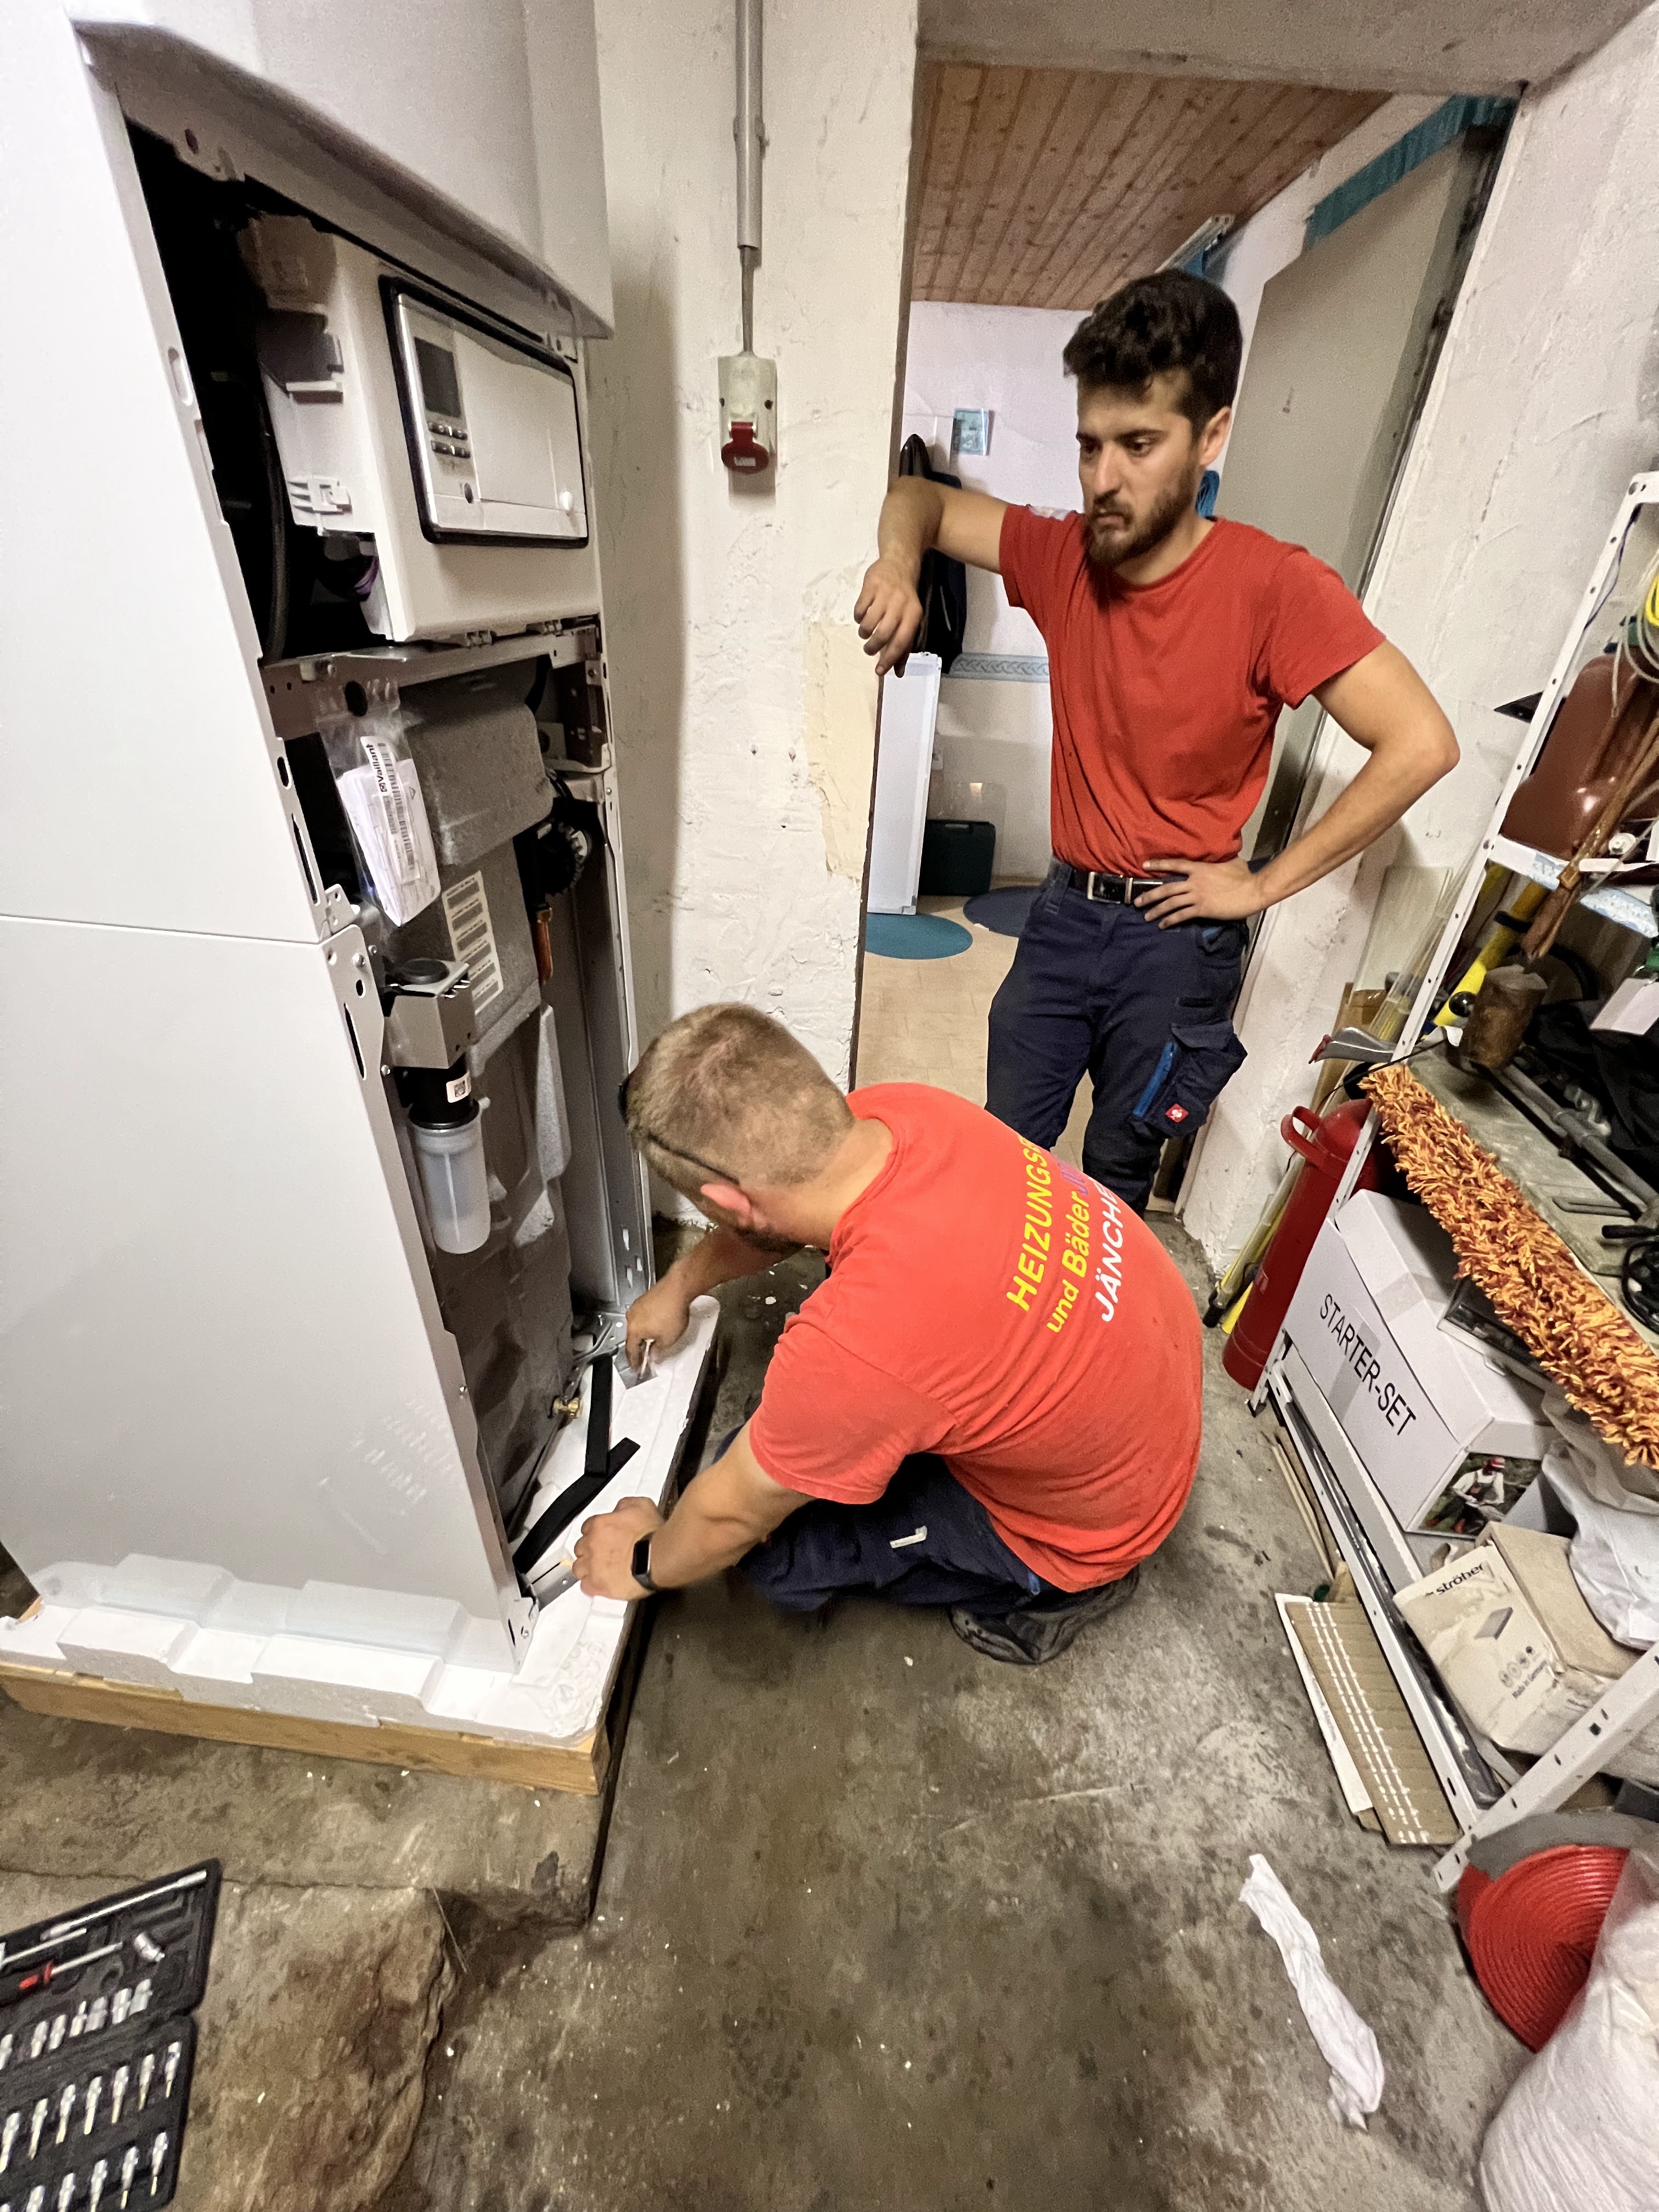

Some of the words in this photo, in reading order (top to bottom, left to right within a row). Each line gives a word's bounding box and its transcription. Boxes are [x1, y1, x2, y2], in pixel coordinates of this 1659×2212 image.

[365, 744, 384, 782] Vaillant
[1062, 1191, 1090, 1278] Bäder
[1088, 1177, 1124, 1322] JÄNCHE
[1047, 1279, 1079, 1333] und
[1320, 1294, 1417, 1436] STARTER-SET
